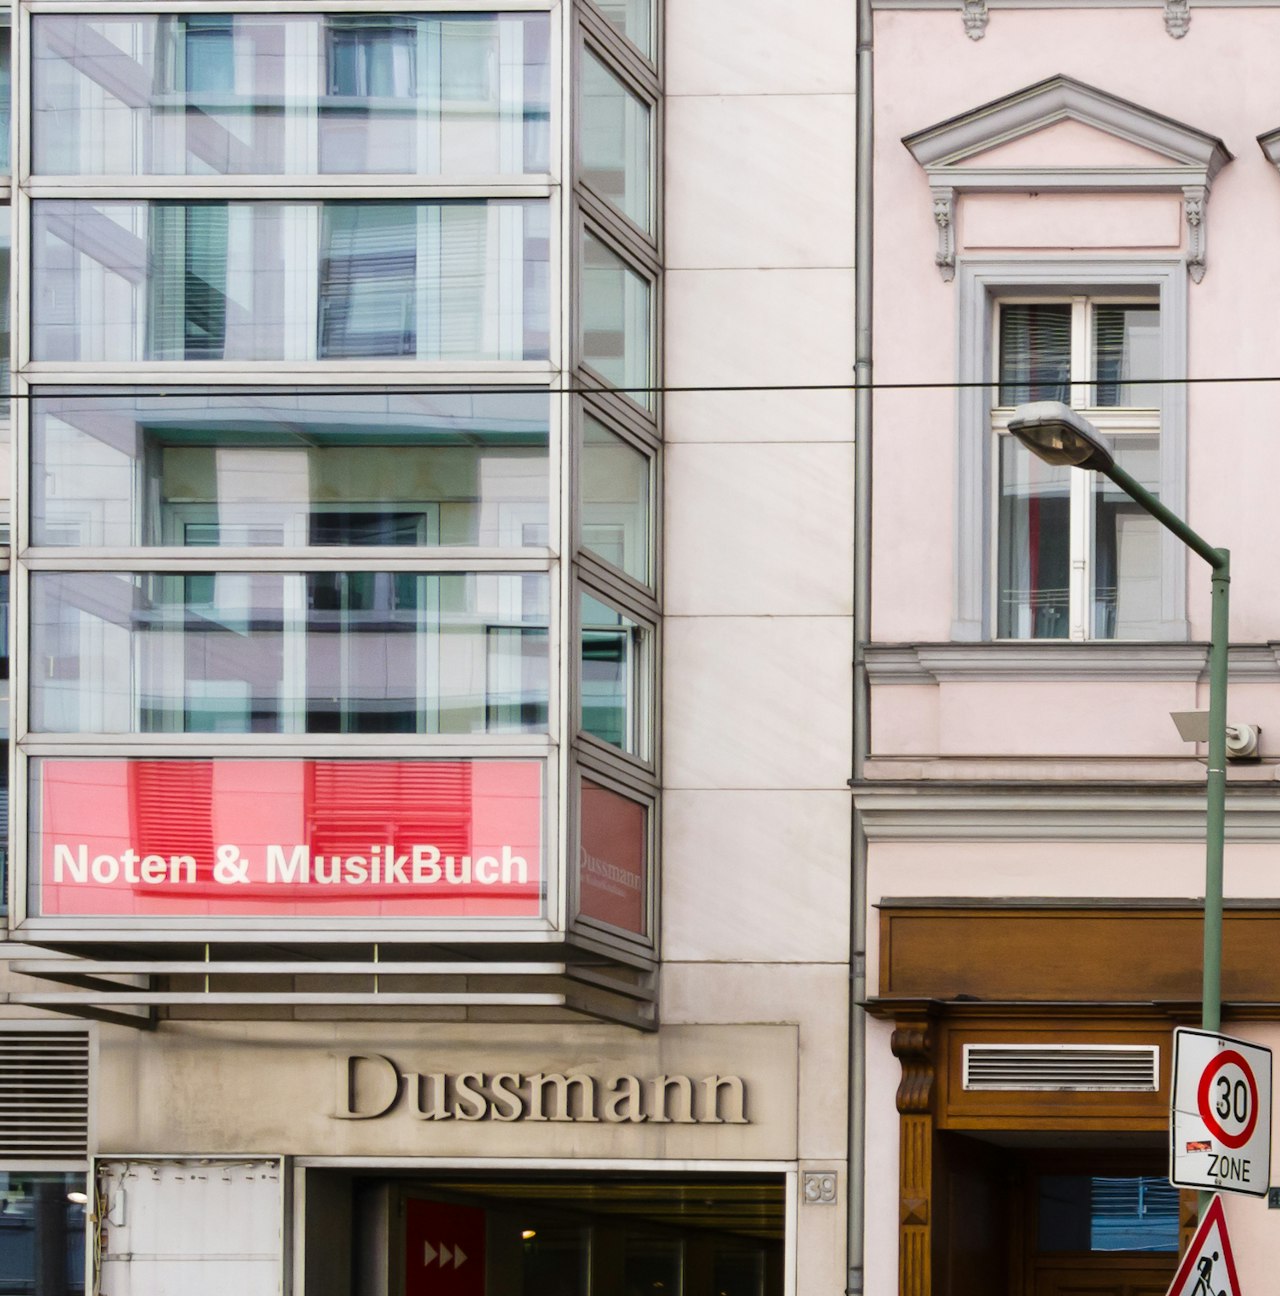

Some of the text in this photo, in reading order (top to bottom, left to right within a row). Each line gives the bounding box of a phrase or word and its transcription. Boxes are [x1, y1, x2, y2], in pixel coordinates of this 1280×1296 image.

[53, 845, 528, 884] Noten & MusikBuch
[329, 1053, 752, 1123] Dussmann
[1217, 1076, 1247, 1123] 30
[1207, 1153, 1251, 1182] ZONE
[804, 1175, 835, 1201] 39
